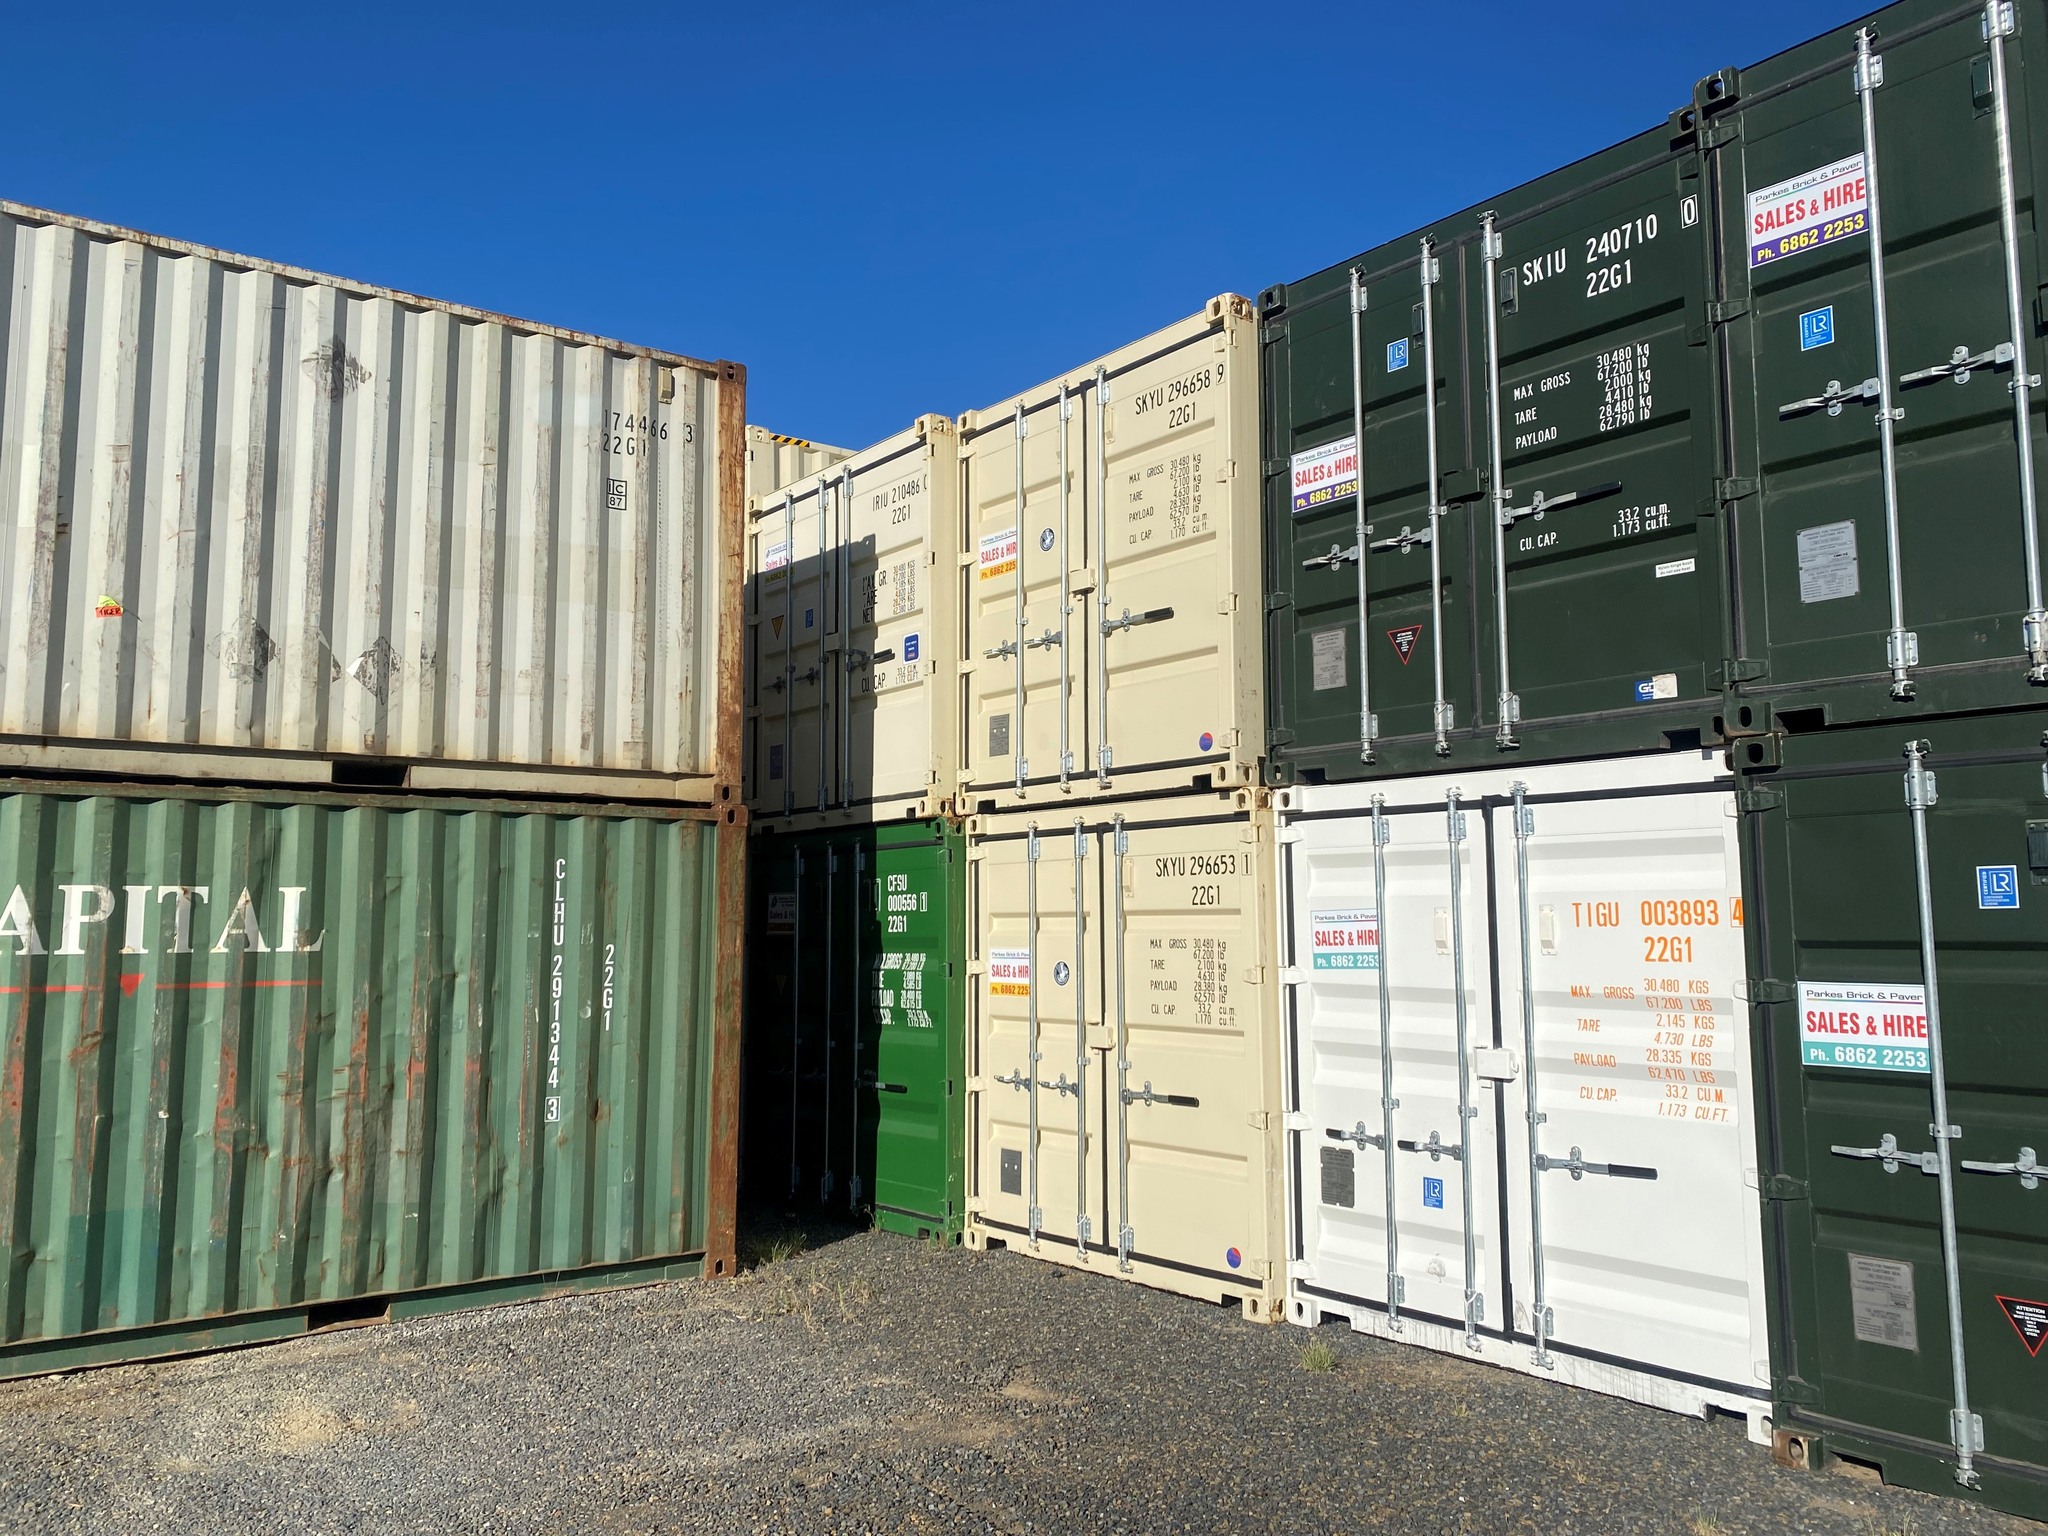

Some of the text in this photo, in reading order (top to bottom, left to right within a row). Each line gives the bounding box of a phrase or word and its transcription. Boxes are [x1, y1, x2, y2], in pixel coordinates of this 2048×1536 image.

[1755, 160, 1862, 203] Parkes Brick & Paver
[1753, 177, 1866, 235] SALES & HIRE
[1522, 198, 1696, 286] SKIU 240710 0
[1757, 213, 1865, 262] Ph. 6862 2253
[1586, 258, 1632, 298] 22G1
[1637, 355, 1648, 369] lb
[1513, 383, 1533, 401] MAX
[1540, 371, 1571, 392] GROSS
[1637, 343, 1650, 358] kg
[1135, 363, 1225, 415] SKYU 296658 9
[1514, 407, 1537, 425] TARE
[1638, 369, 1651, 384] kg
[1639, 381, 1649, 395] lb
[1168, 401, 1197, 429] 22G1
[1515, 426, 1557, 449] PAYLOAD
[1639, 395, 1652, 410] kg
[1640, 407, 1650, 420] lb
[604, 409, 693, 443] 174466 3
[603, 433, 647, 456] 22G1
[1296, 449, 1332, 463] Parkes Brick
[1128, 472, 1140, 485] MAX
[1147, 464, 1164, 478] GROSS
[1295, 454, 1358, 488] SALES & HIRE
[608, 496, 622, 508] 87
[872, 491, 888, 512] IRIU
[892, 478, 920, 504] 210486
[1129, 490, 1143, 503] TARE
[1296, 480, 1358, 508] Ph. 6862 2253
[892, 503, 911, 525] 22G1
[1128, 506, 1154, 523] PAYLOAD
[1645, 513, 1671, 531] cu.ft.
[1519, 503, 1671, 551] CU. CAP. 33.2 cu.m.
[981, 541, 1017, 564] SALES & HIR
[990, 561, 1016, 577] 6862 225
[1155, 855, 1185, 878] SKYU
[1189, 854, 1236, 876] 296653
[887, 874, 907, 892] CFSU
[887, 894, 917, 912] 000556
[1191, 885, 1221, 906] 22G1
[1571, 898, 1744, 928] TIGU 003893 4
[887, 915, 907, 933] 22G1
[1149, 938, 1162, 949] MAX
[1168, 938, 1187, 949] GROSS
[1217, 938, 1226, 952] kg
[1314, 930, 1345, 947] SALES
[1347, 931, 1354, 946] &
[1217, 949, 1224, 960] lb
[1644, 936, 1693, 963] 22G1
[1150, 959, 1165, 970] TARE
[1217, 960, 1226, 974] kg
[1317, 955, 1379, 967] Ph. 6862 2253
[991, 964, 1029, 978] SALES & HIR
[546, 858, 566, 1120] CLHU 291344 3
[602, 943, 615, 1031] 22G1
[1000, 985, 1015, 995] 6862
[1150, 980, 1178, 991] PAYLOAD
[1570, 978, 1709, 1000] MAX. GROSS 30.480 KGS
[1690, 998, 1713, 1012] LBS
[1806, 989, 1923, 1002] Parkes Brick & Paver
[1197, 1003, 1211, 1014] 33.2
[1577, 1013, 1715, 1032] TARE 2.145 KGS
[1806, 1010, 1927, 1039] SALES & HIRE
[1654, 1031, 1714, 1048] 4.730 LBS
[1573, 1052, 1616, 1068] PAYLOAD
[1691, 1051, 1712, 1067] KGS
[1809, 1046, 1928, 1068] Ph. 6862 2253
[1692, 1070, 1716, 1084] LBS
[1665, 1084, 1688, 1100] 33.2
[1697, 1087, 1727, 1104] CU.M.
[1694, 1106, 1729, 1123] CU.FT.
[2015, 1305, 2046, 1314] ATTENTION
